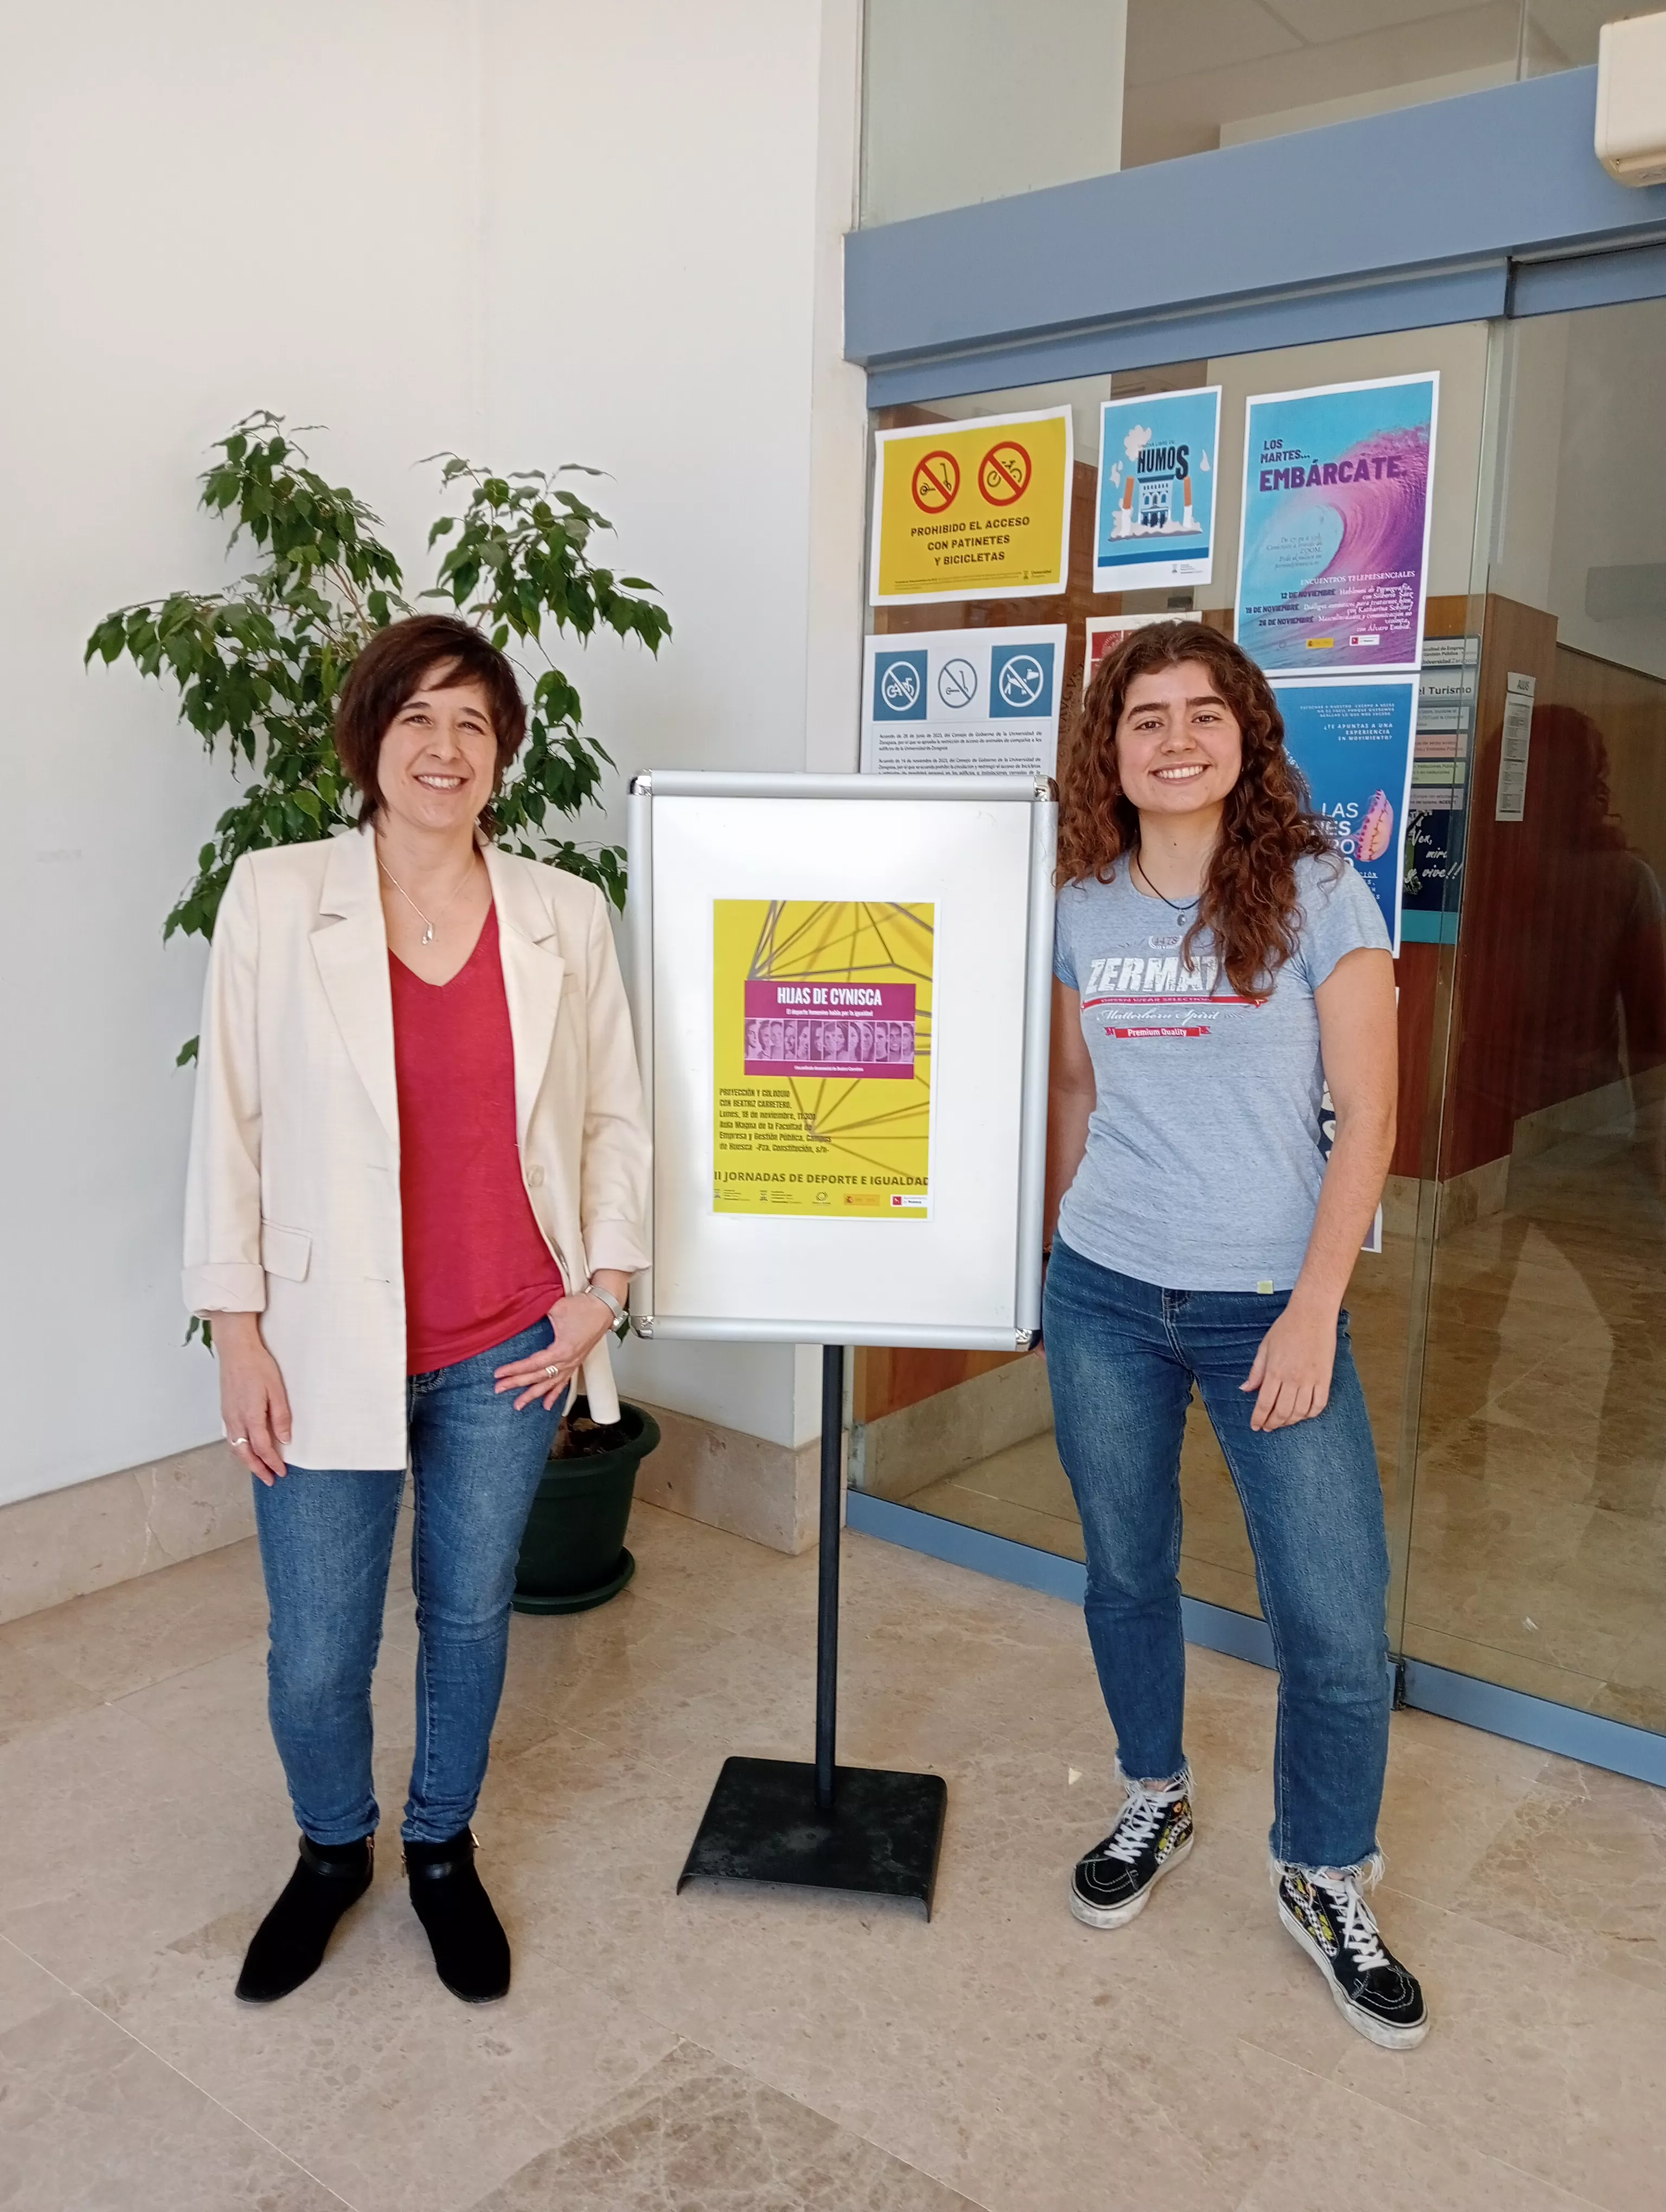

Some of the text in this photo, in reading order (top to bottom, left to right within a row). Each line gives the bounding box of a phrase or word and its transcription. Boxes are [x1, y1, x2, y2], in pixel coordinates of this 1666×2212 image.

[1264, 439, 1283, 451] LOS
[1137, 443, 1189, 480] HUMOS
[911, 516, 1030, 537] PROHIBIDO EL ACCESO
[927, 535, 1010, 551] CON PATINETES
[934, 551, 1005, 566] Y BICICLETAS
[1300, 570, 1415, 586] ENCUENTROS TELEPRESENCIALES
[1298, 589, 1336, 598] NOVIEMBRE
[1263, 603, 1299, 613] NOVIEMBRE
[1277, 616, 1314, 625] NOVIEMBRE
[1428, 686, 1471, 695] Turismo
[1322, 802, 1359, 818] LAS
[1085, 956, 1218, 994] ZERMAT
[777, 987, 883, 1006] HIJAS DE CYNISCA
[1176, 1009, 1220, 1026] Spirit
[1127, 1028, 1187, 1037] Premium Quality
[722, 1171, 786, 1182] JORNADAS
[790, 1173, 803, 1183] DE
[806, 1173, 857, 1185] DEPORTE
[861, 1175, 868, 1185] E
[870, 1175, 928, 1186] IGUALDAD
